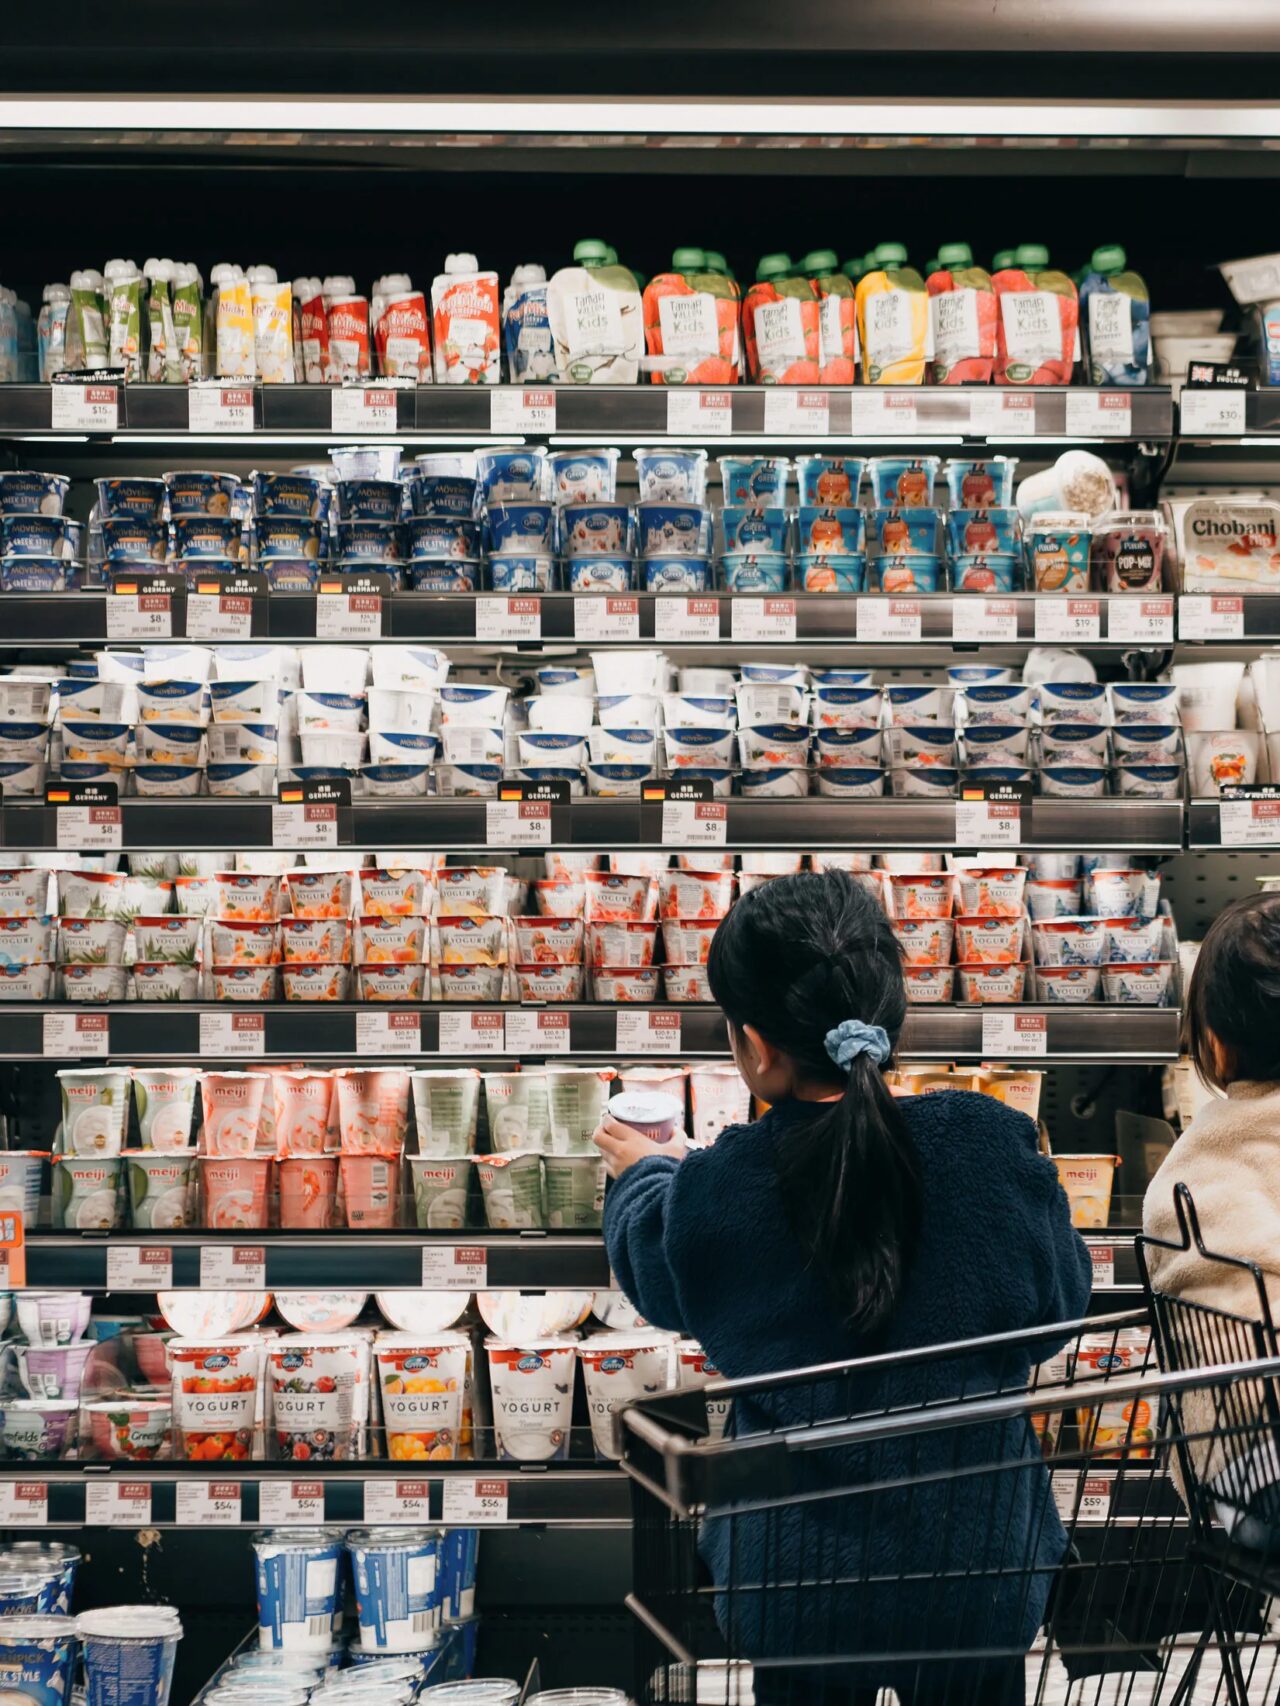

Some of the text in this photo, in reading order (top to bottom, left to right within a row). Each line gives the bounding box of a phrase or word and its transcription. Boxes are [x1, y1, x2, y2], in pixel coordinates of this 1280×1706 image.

[578, 315, 608, 330] Kids
[673, 320, 704, 333] Kids
[874, 318, 898, 331] Kids
[939, 318, 965, 332] Kids
[1017, 318, 1048, 330] Kids
[1095, 320, 1119, 332] Kids
[764, 326, 790, 342] Kids
[1216, 375, 1249, 385] ENGLAND
[1192, 518, 1276, 537] Chobani
[1118, 557, 1152, 570] POP-MIX
[142, 587, 176, 595] GERMANY
[225, 586, 259, 595] GERMANY
[347, 585, 380, 594] GERMANY
[75, 793, 108, 801] GERMANY
[308, 791, 342, 800] GERMANY
[528, 792, 560, 800] GERMANY
[670, 791, 703, 800] GERMANY
[310, 811, 331, 819] SPECIAL
[700, 810, 722, 818] SPECIAL
[367, 889, 404, 898] YOGURT
[372, 936, 408, 944] YOGURT
[450, 936, 488, 944] YOGURT
[973, 938, 1009, 946] YOGURT
[223, 986, 261, 995] YOGURT
[291, 984, 328, 992] YOGURT
[374, 984, 411, 992] YOGURT
[529, 984, 567, 992] YOGURT
[978, 985, 1014, 993] YOGURT
[67, 1085, 97, 1097] meiji
[147, 1083, 178, 1095] meiji
[214, 1086, 247, 1098] meiji
[286, 1085, 319, 1097] meiji
[73, 1168, 106, 1181] meiji
[148, 1167, 181, 1179] meiji
[209, 1168, 240, 1180] meiji
[423, 1168, 456, 1181] meiji
[1066, 1168, 1097, 1181] meiji
[187, 1400, 247, 1412] YOGURT
[389, 1400, 449, 1412] YOGURT
[501, 1402, 560, 1413] YOGURT
[14, 1671, 40, 1682] STYLE
